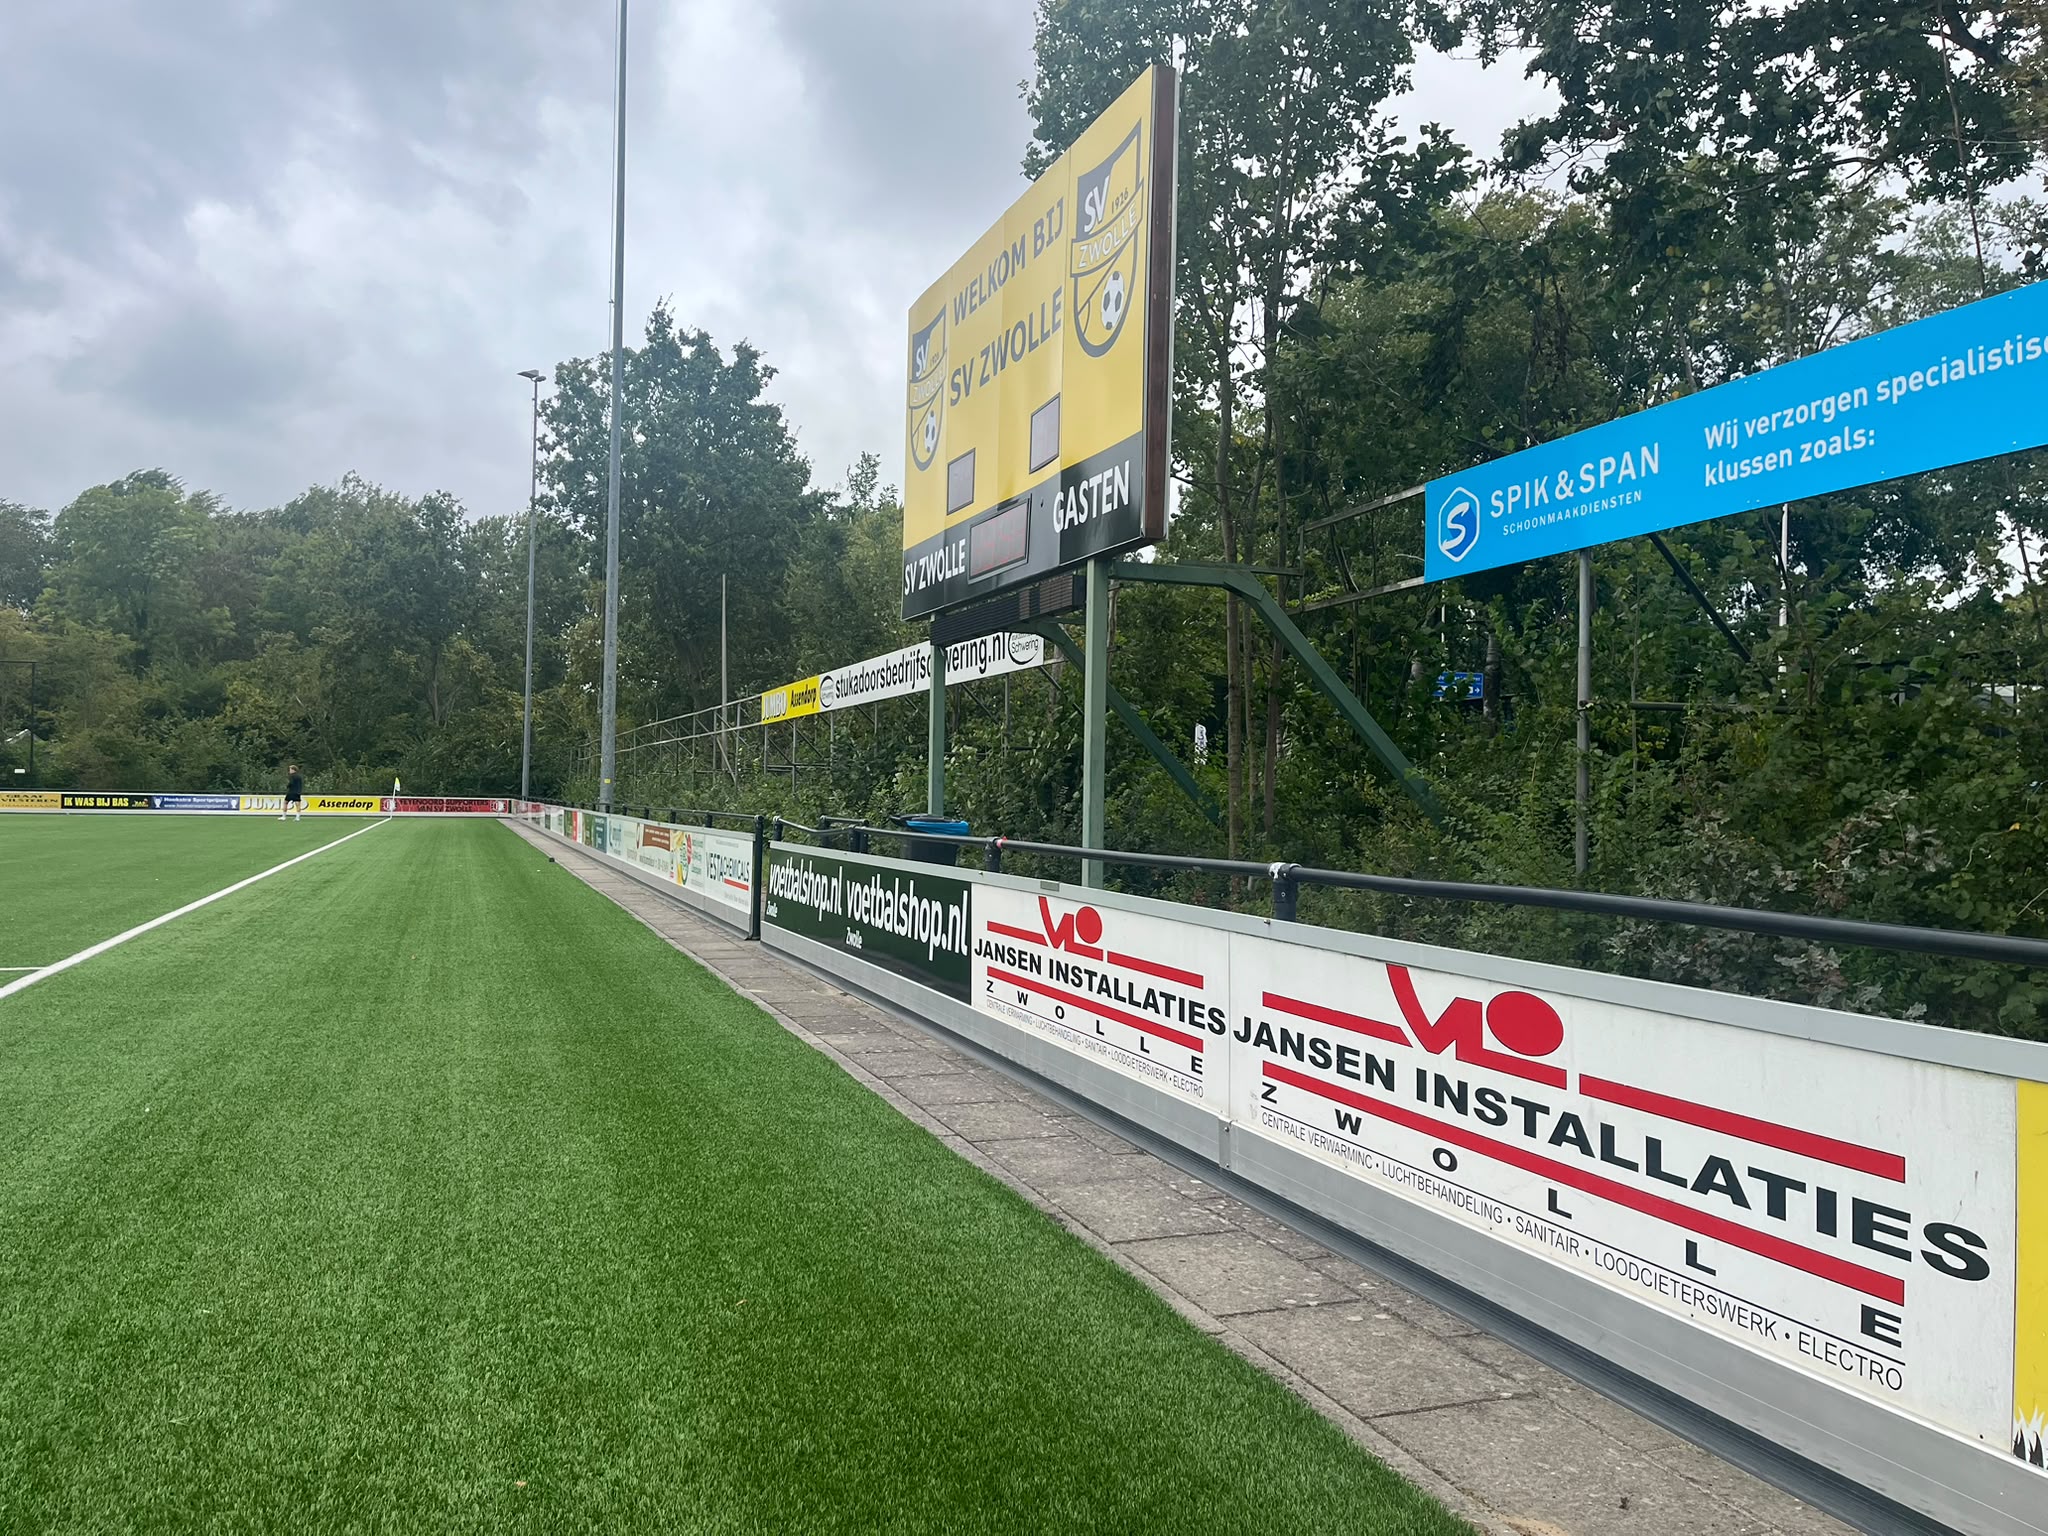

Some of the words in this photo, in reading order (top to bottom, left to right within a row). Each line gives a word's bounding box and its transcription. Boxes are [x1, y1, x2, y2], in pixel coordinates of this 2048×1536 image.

[1083, 174, 1110, 235] SV
[1110, 187, 1129, 215] 1926
[953, 233, 1026, 327] WELKOM
[1033, 196, 1064, 260] BIJ
[1077, 201, 1137, 270] ZWOLLE
[915, 338, 930, 379] SV
[950, 357, 974, 407] SV
[979, 285, 1063, 388] ZWOLLE
[1704, 418, 1738, 450] Wij
[1744, 386, 1868, 438] verzorgen
[1489, 475, 1549, 518] SPIK
[1554, 469, 1574, 501] &
[1579, 441, 1659, 494] SPAN
[1705, 447, 1793, 487] klussen
[1799, 425, 1875, 464] zoals:
[1053, 459, 1130, 534] GASTEN
[1502, 488, 1642, 537] SCHOONMAAKDIENSTEN
[904, 571, 917, 596] SV
[919, 538, 967, 591] ZWOLLE
[1011, 638, 1039, 654] Schwering
[790, 684, 817, 709] Assendorp
[64, 797, 73, 806] IK
[75, 797, 95, 807] WAS
[96, 797, 110, 807] BIJ
[112, 797, 129, 807] BAS
[318, 799, 373, 810] Assendorp
[766, 900, 778, 918] Zwolle
[769, 856, 843, 922] voetbalshop.nl
[846, 873, 968, 962] voetbalshop.nl
[846, 926, 863, 950] Zwolle
[974, 938, 1042, 975] JANSEN
[1049, 957, 1227, 1036] INSTALLATIES
[1173, 1074, 1204, 1098] ELECTRO
[1233, 1016, 1395, 1093] JANSEN
[1416, 1067, 1991, 1282] INSTALLATIES
[1261, 1111, 1306, 1142] CENTRALE
[1382, 1160, 1503, 1224] LUCHTBEHANDELING
[1515, 1215, 1580, 1258] SANITAIR
[1798, 1331, 1904, 1392] ELECTRO
